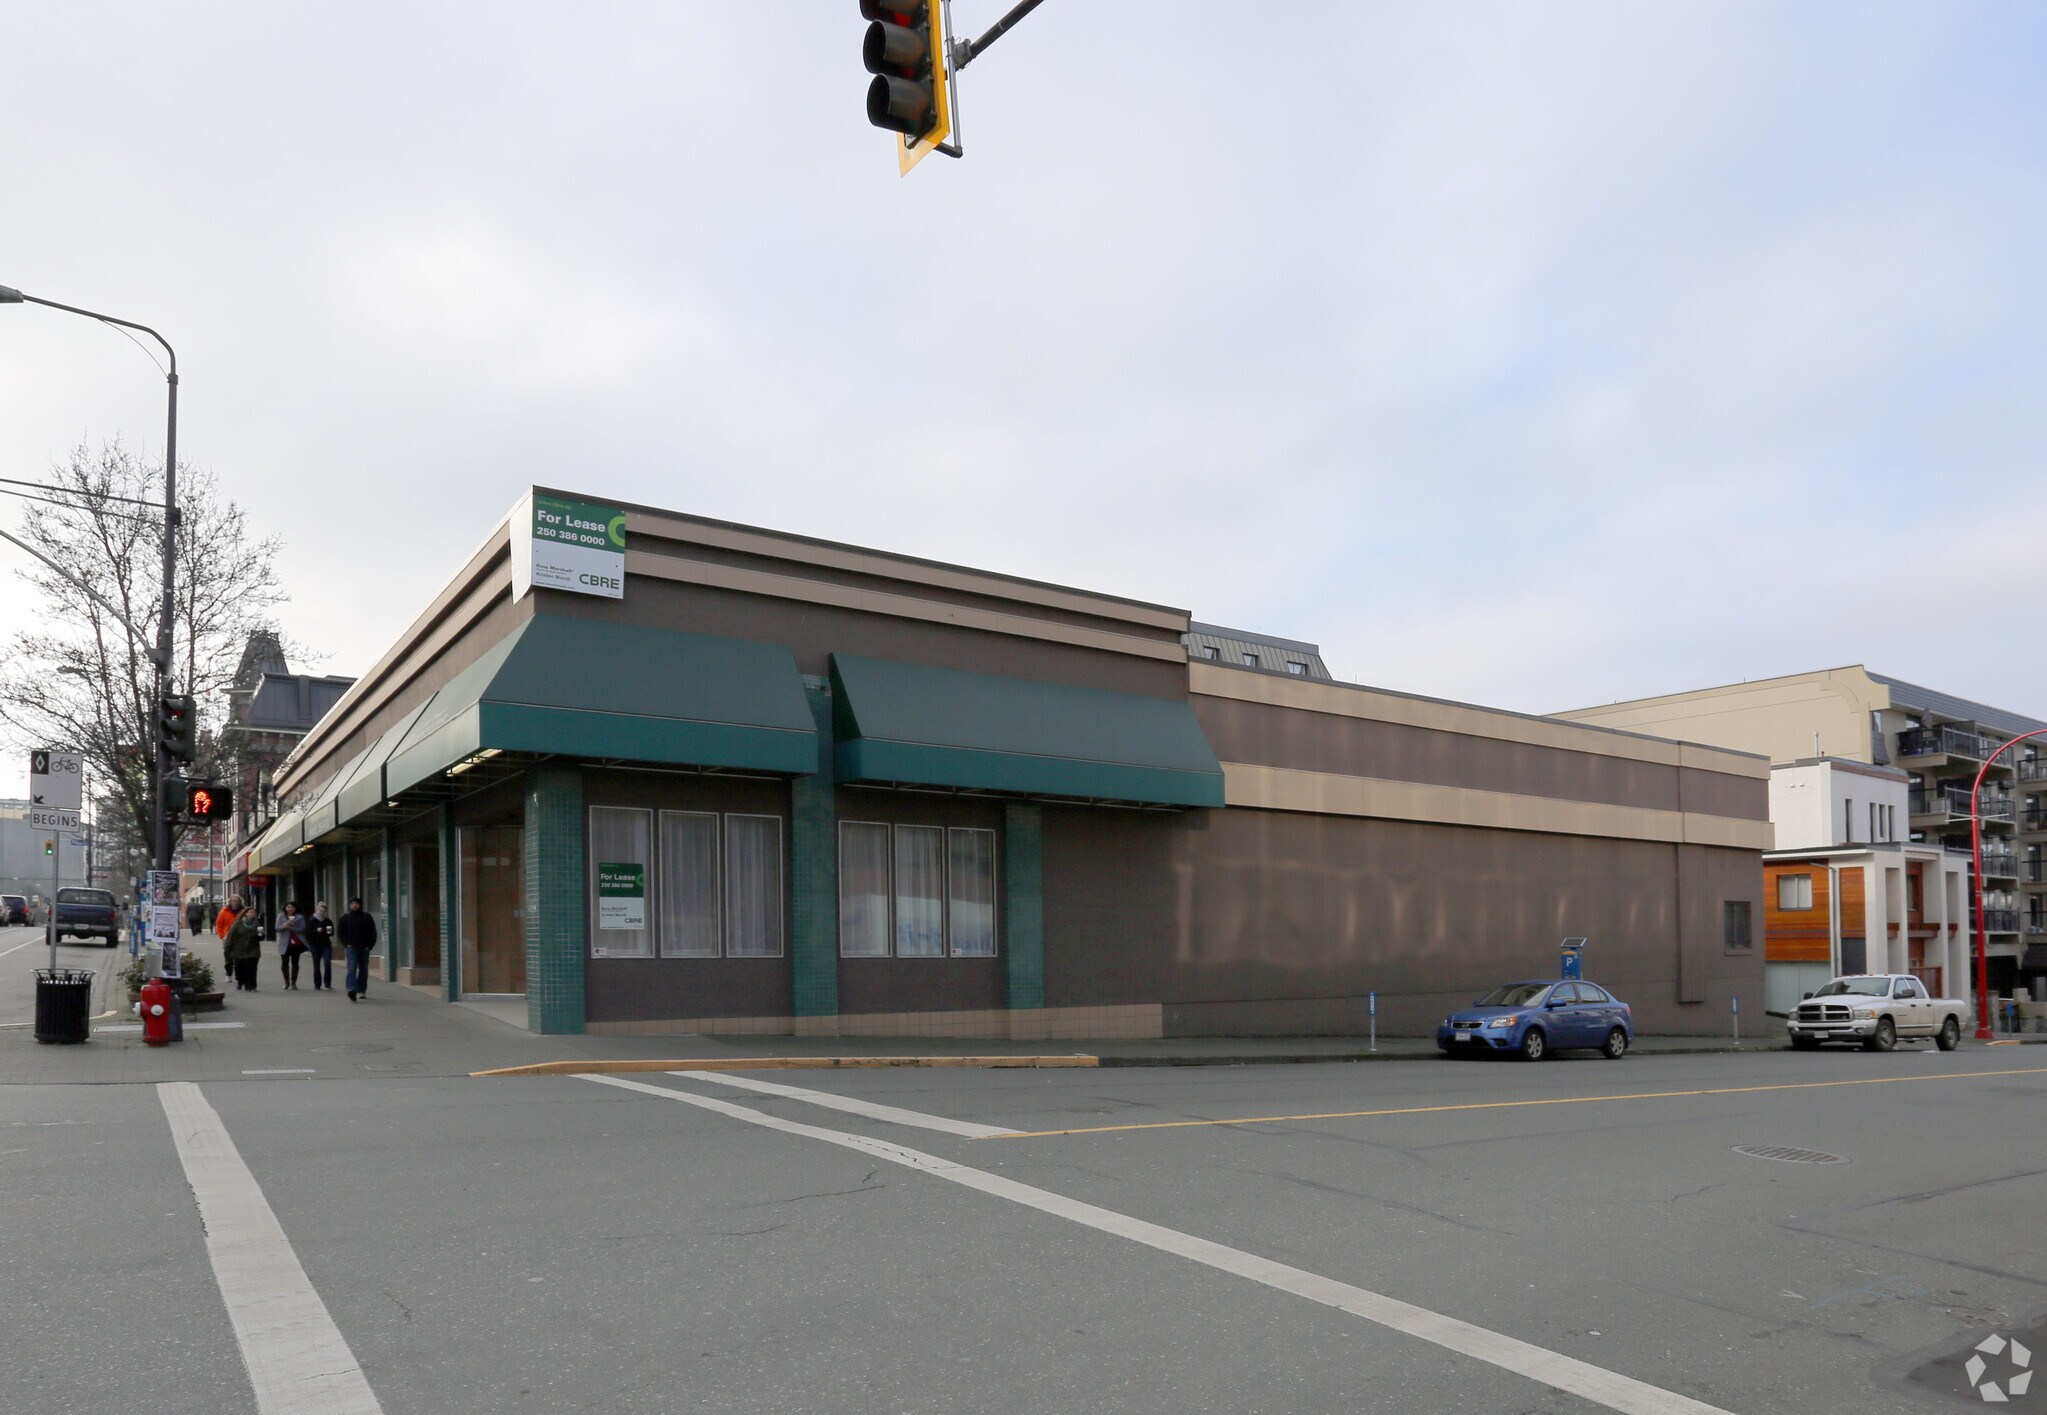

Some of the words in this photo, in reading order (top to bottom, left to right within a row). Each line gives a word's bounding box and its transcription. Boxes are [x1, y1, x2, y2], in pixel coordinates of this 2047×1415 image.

[537, 509, 562, 525] For
[565, 514, 606, 533] Lease
[536, 526, 557, 538] 250
[558, 530, 578, 541] 386
[580, 534, 605, 546] 0000
[579, 573, 620, 590] CBRE
[33, 814, 77, 827] BEGINS
[1566, 958, 1573, 967] P
